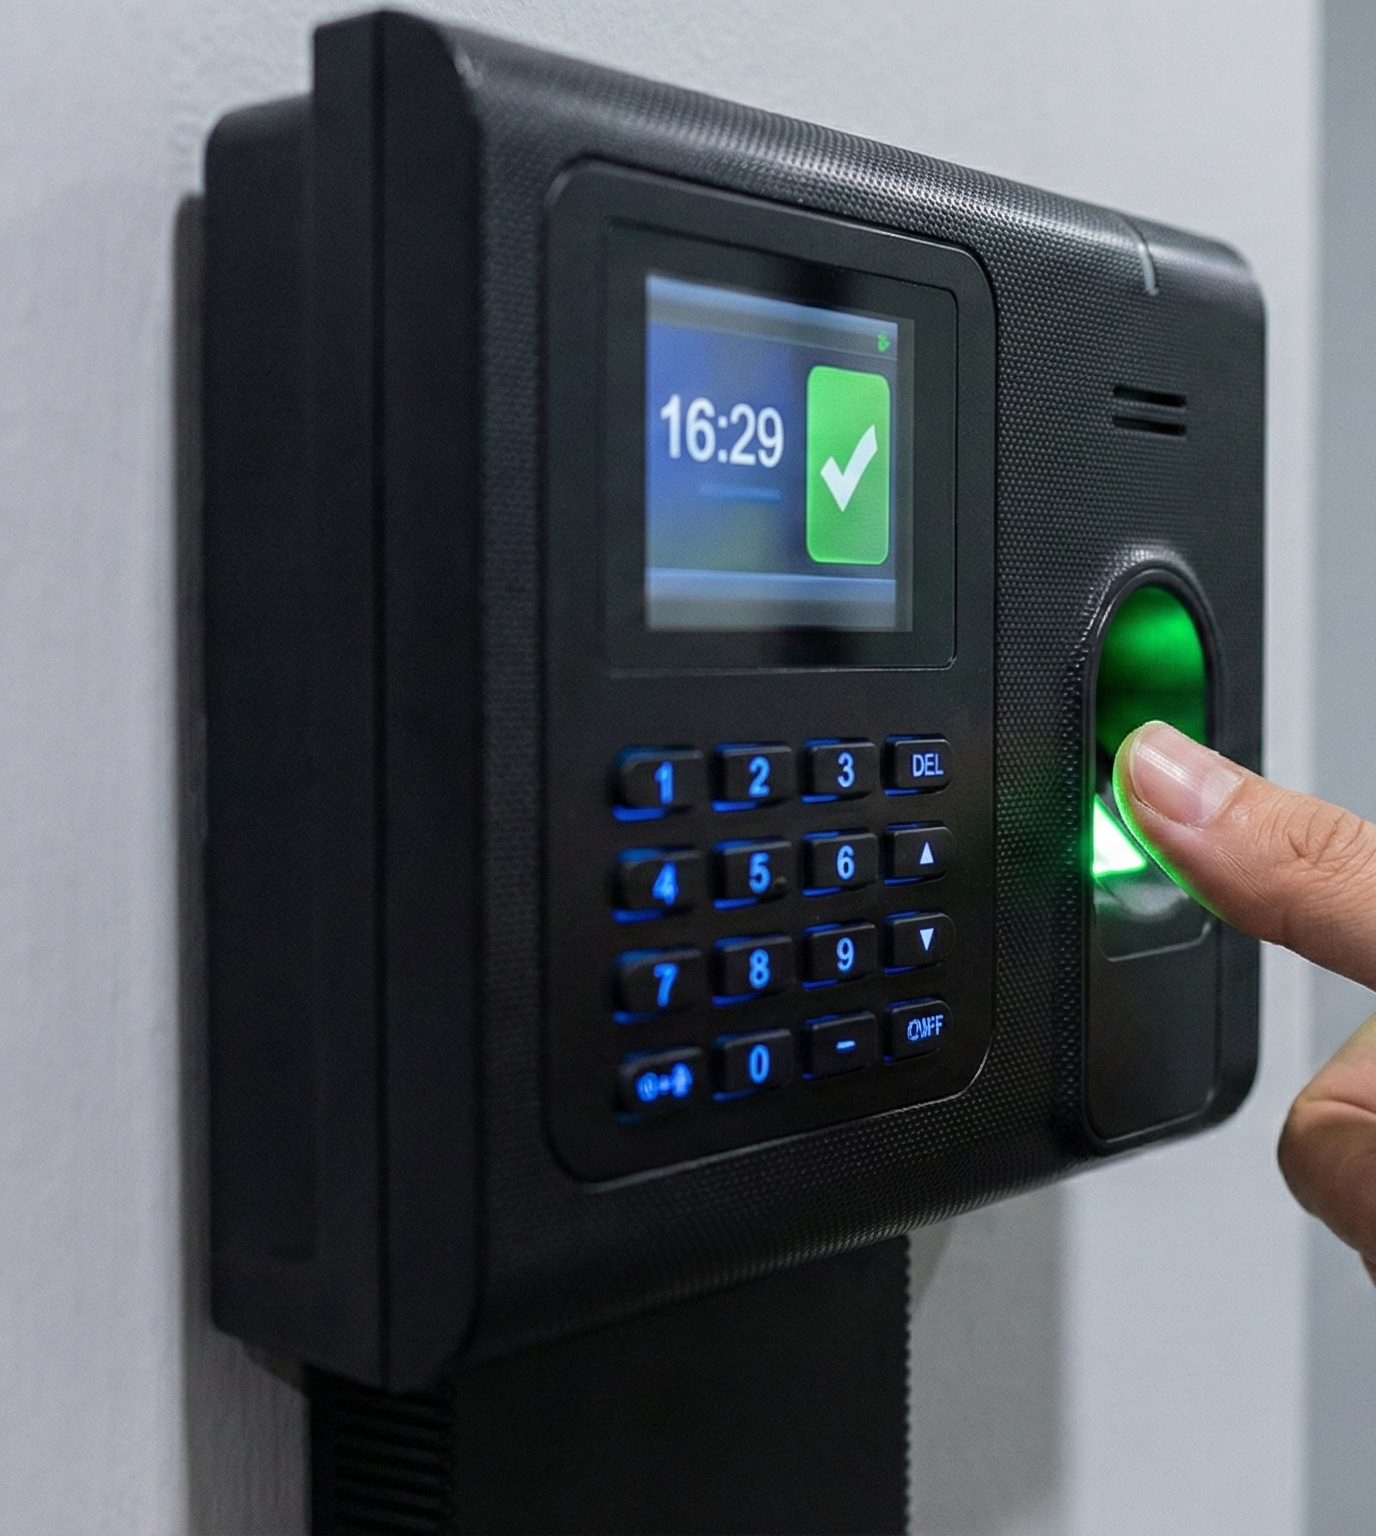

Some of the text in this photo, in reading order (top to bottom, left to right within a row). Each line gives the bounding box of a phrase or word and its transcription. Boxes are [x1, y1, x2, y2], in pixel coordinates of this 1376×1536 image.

[660, 394, 785, 468] 16:29
[653, 752, 944, 805] 1 2 3 DEL
[652, 845, 855, 906] 4 5 6
[653, 937, 855, 1007] 7 8 9
[748, 1044, 771, 1084] 0
